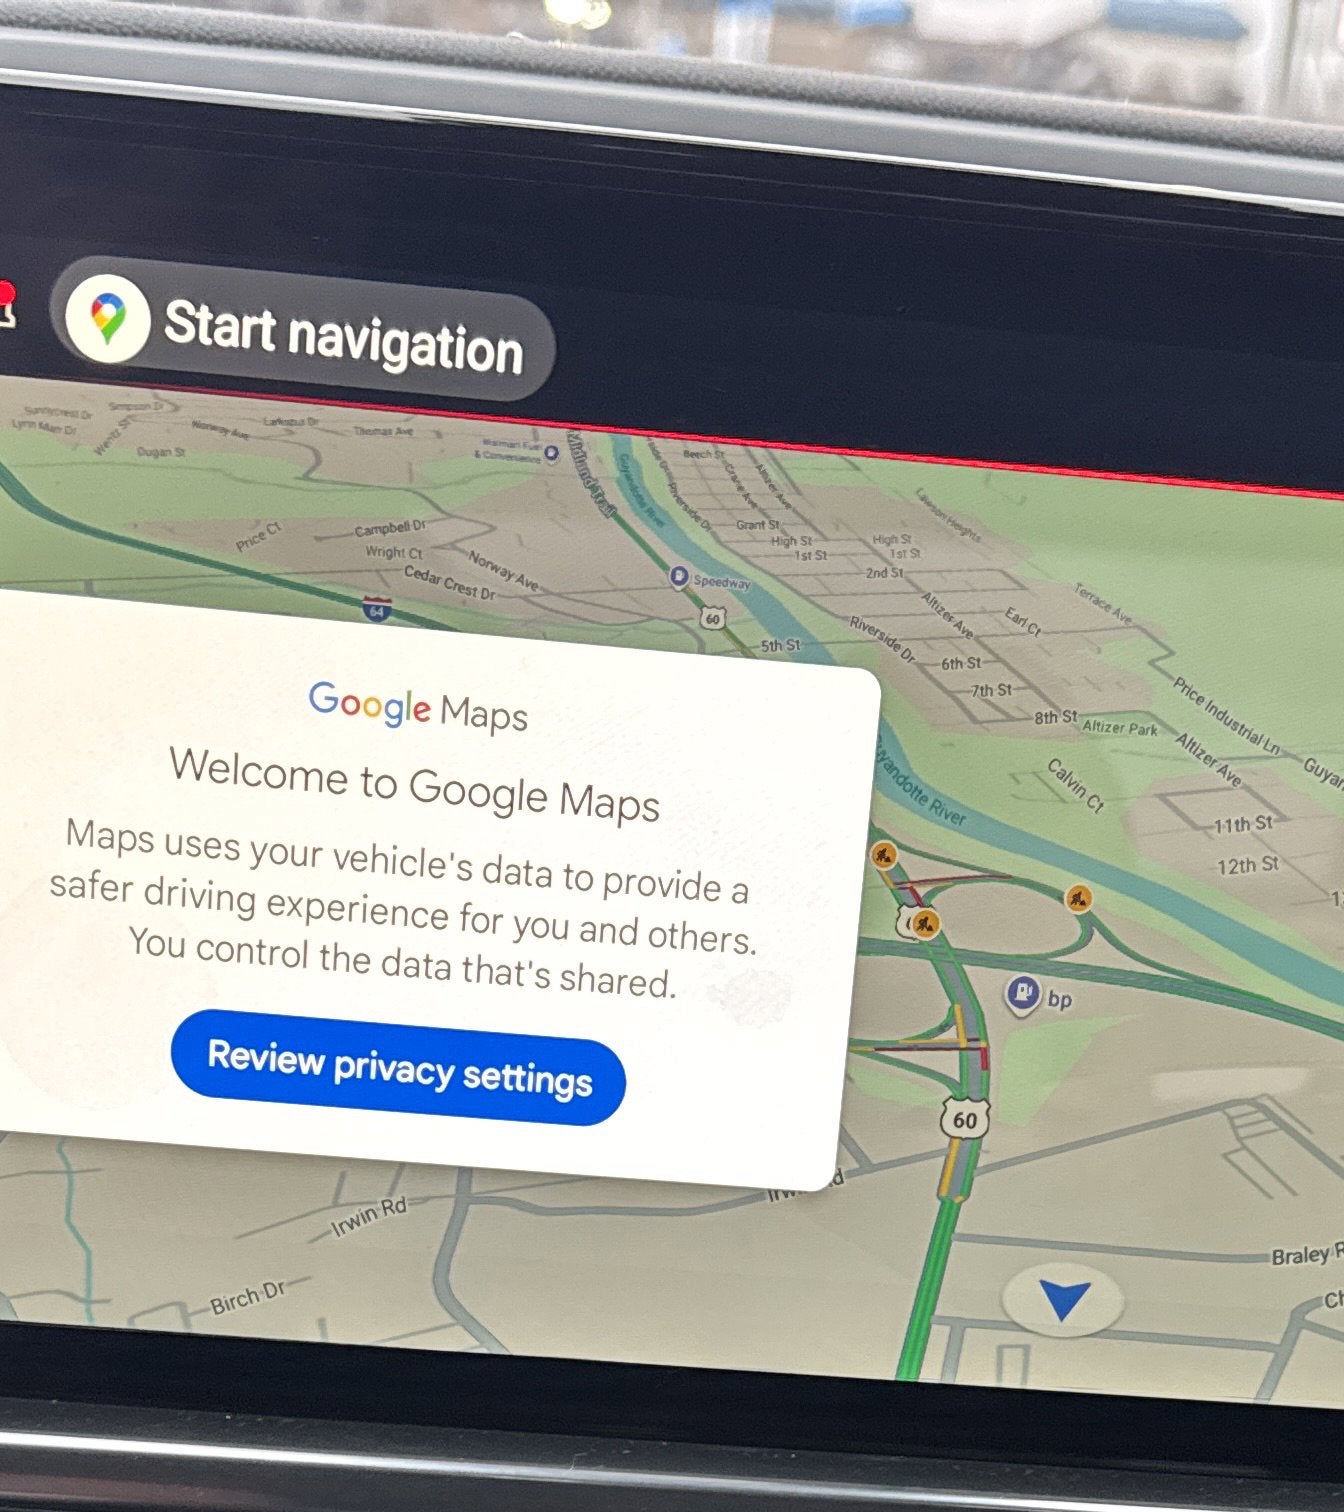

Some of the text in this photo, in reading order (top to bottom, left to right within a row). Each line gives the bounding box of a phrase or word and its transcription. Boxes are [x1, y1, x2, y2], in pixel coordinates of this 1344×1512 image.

[164, 299, 524, 375] Start navigation
[137, 446, 172, 459] Dugan
[235, 521, 282, 552] Price Ct
[355, 519, 426, 538] Campbell Dr
[771, 535, 812, 548] High St
[873, 534, 898, 547] High
[365, 546, 423, 560] Wright Ct
[794, 550, 827, 561] 1st St
[890, 548, 921, 560] 1st St
[468, 550, 540, 592] Norway Ave
[866, 567, 904, 579] 2nd St
[404, 564, 496, 601] Cedar Crest Dr
[694, 575, 751, 592] Speedway
[370, 605, 384, 617] 64
[1073, 582, 1134, 626] Terrace Ave
[706, 613, 720, 625] 60
[921, 591, 975, 641] Altizer Ave
[850, 615, 916, 665] Riverside Dr
[1026, 621, 1043, 639] Ct
[761, 639, 801, 652] 5th St
[942, 657, 982, 671] 6th St
[971, 683, 1012, 699] 7th St
[308, 680, 529, 735] Google Maps
[1034, 710, 1078, 725] 8th St
[1172, 675, 1282, 757] Price Industrial Ln
[1082, 719, 1158, 738] Altizer Park
[1175, 732, 1244, 789] Altizer Ave
[168, 745, 662, 829] Welcome to Google Maps
[876, 733, 967, 826] yandotte River
[1047, 757, 1105, 815] Calvin Ct
[1214, 815, 1273, 833] 11th St
[64, 817, 750, 909] Maps uses your vehicle's data to provide a
[1218, 855, 1280, 876] 12th St
[49, 870, 758, 957] safer driving experience for you and others.
[128, 925, 678, 1001] You control the data that's shared.
[1048, 990, 1073, 1011] bp
[207, 1038, 594, 1102] Review privacy settings
[953, 1111, 978, 1129] 60
[330, 1195, 408, 1239] Irwin Rd
[1272, 1244, 1330, 1267] Braley
[210, 1279, 286, 1317] Birch Dr
